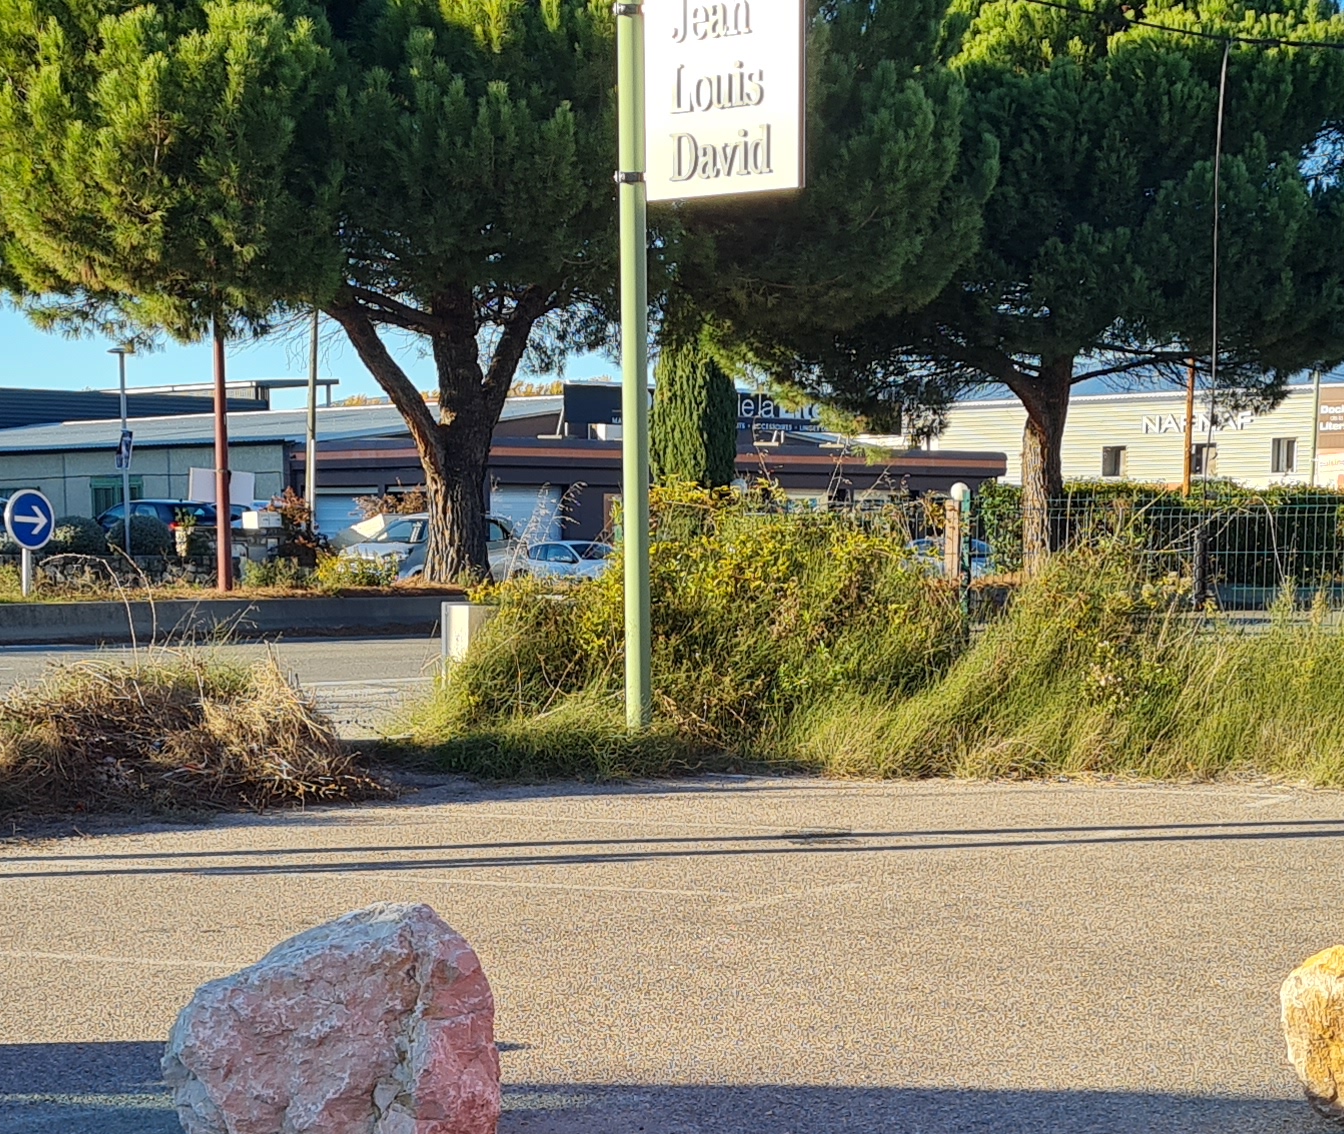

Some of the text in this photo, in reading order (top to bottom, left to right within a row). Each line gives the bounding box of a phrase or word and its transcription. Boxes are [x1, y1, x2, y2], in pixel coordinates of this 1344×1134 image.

[672, 0, 752, 43] Jean
[670, 60, 764, 114] Louis
[669, 123, 773, 182] David
